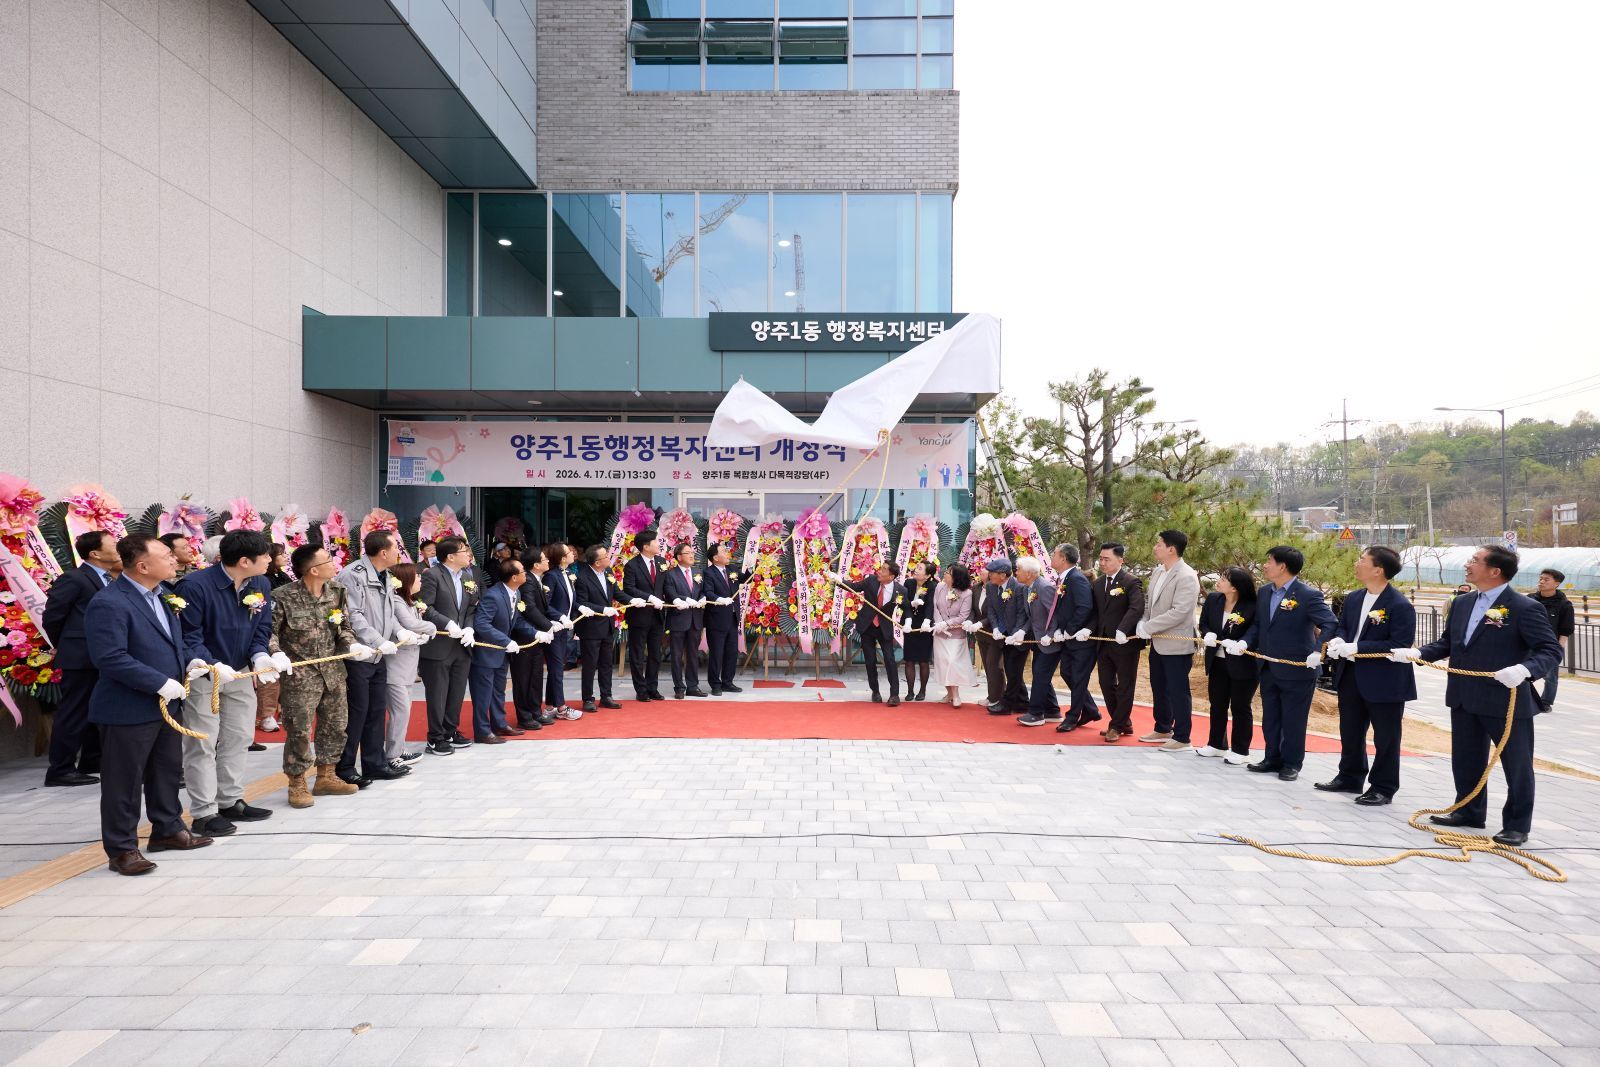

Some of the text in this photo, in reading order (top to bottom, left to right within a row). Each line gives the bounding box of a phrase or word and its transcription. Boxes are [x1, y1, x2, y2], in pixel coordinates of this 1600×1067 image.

[751, 320, 946, 342] 양주1동 행정복지센터
[555, 469, 581, 479] 2026.
[702, 470, 830, 480] 양주1동 복합청사 다목적강당(4F)
